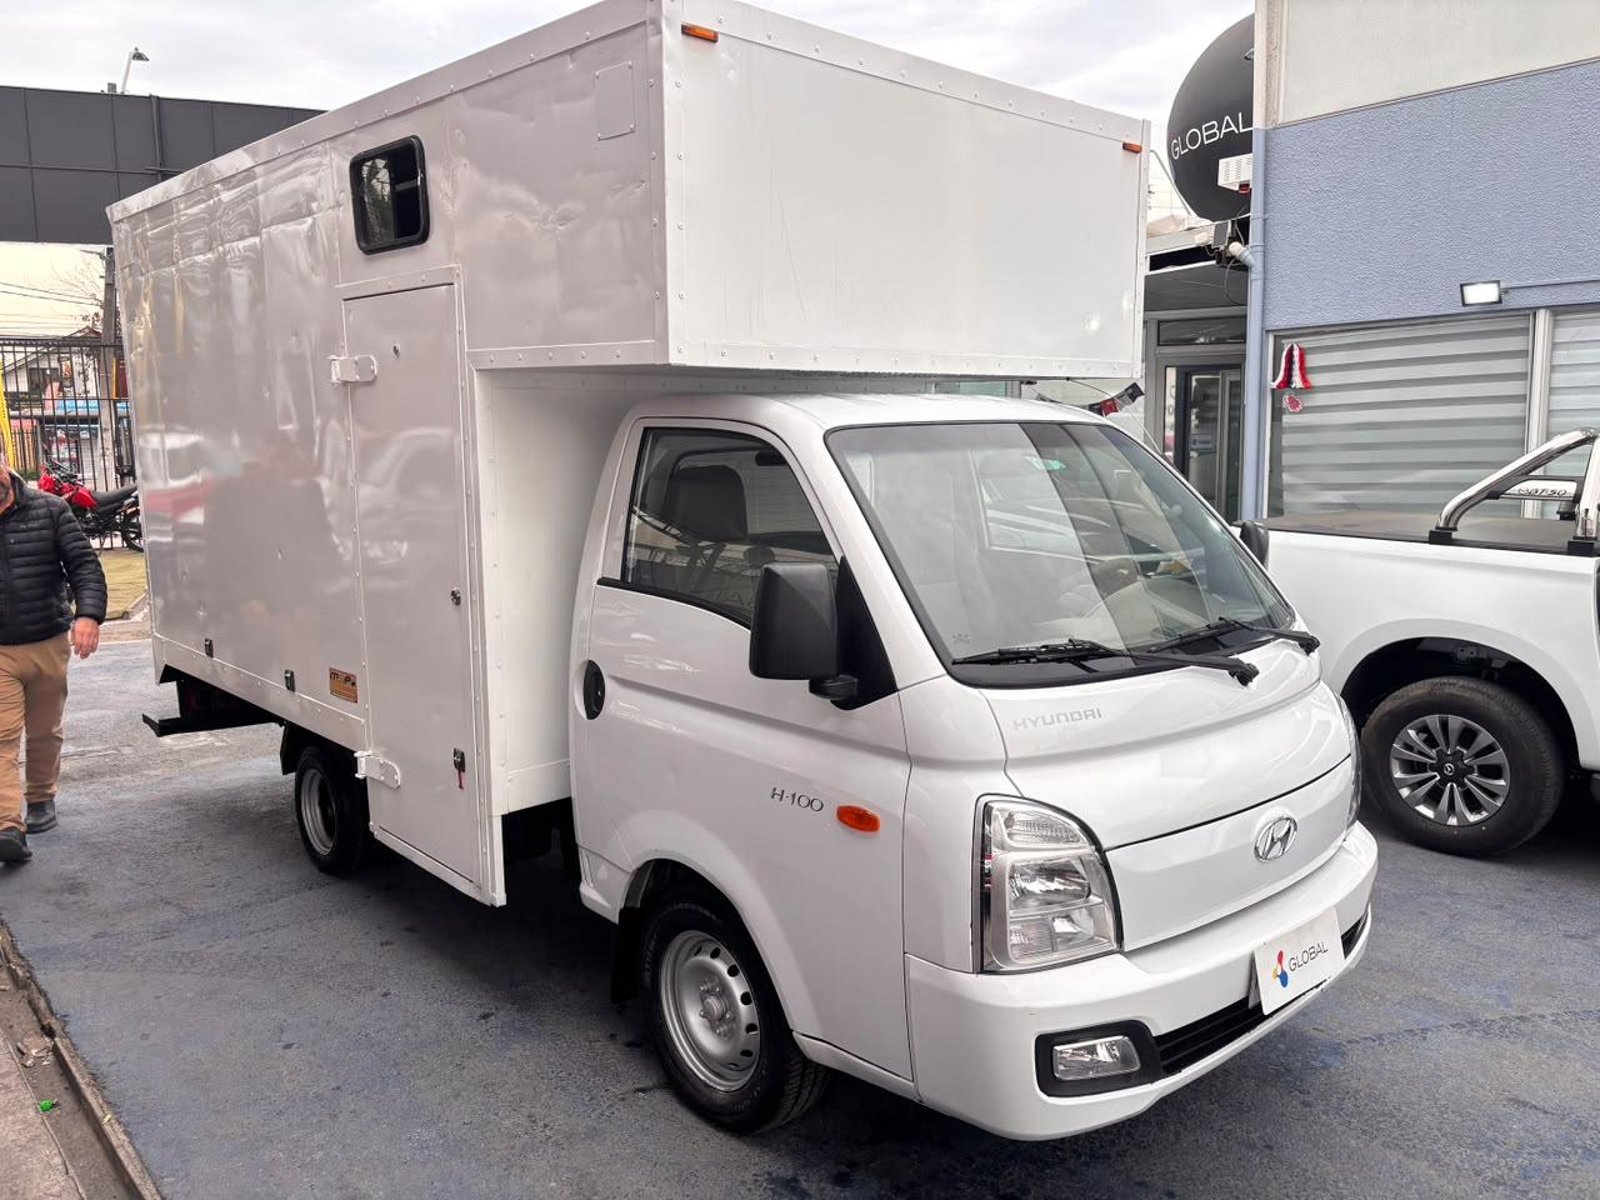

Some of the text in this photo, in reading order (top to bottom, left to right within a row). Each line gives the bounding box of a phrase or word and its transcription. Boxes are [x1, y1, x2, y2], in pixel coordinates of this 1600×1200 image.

[1171, 112, 1253, 160] GLOBAL
[1013, 708, 1102, 730] HYUNDAI
[771, 787, 824, 812] H-100
[1288, 941, 1328, 972] GLOBAL
